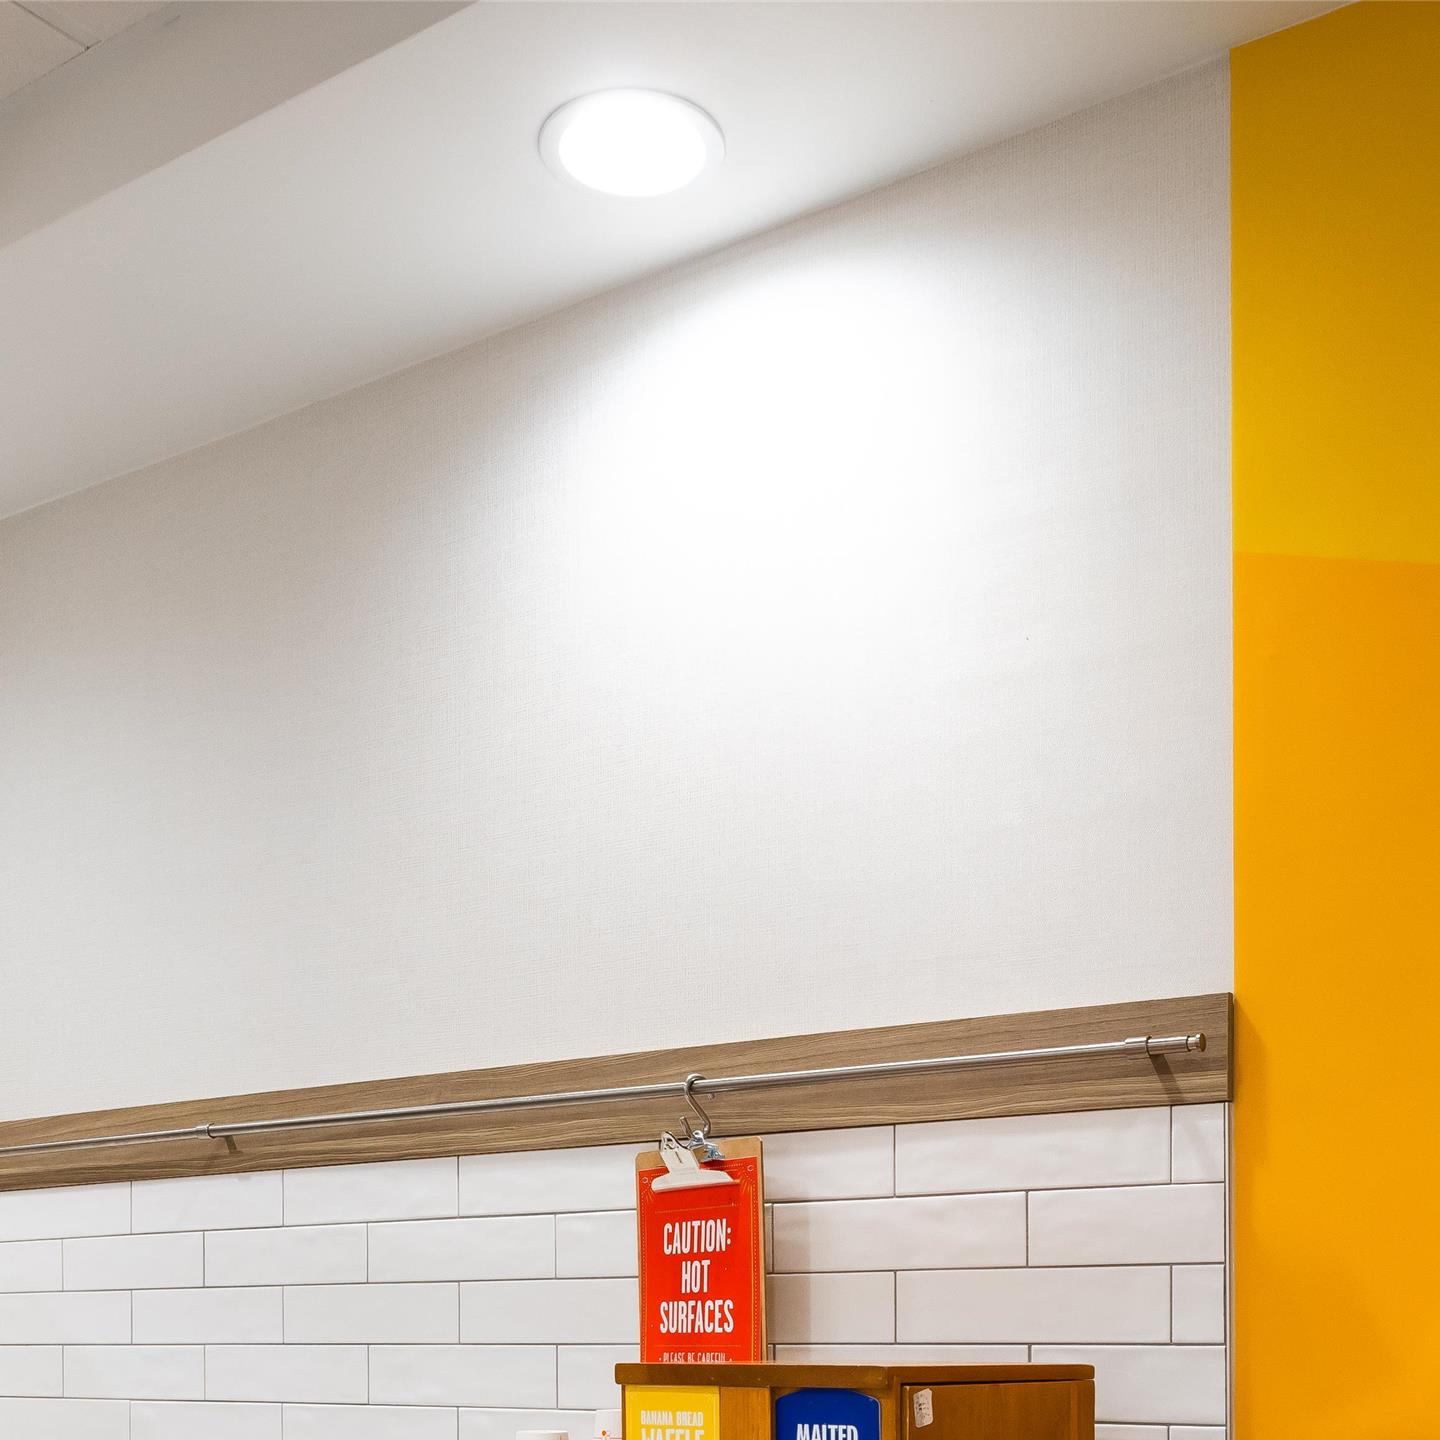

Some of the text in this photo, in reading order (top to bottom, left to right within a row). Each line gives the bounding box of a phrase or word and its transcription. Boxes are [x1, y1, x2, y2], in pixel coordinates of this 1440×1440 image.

[663, 1218, 732, 1255] CAUTION:
[681, 1259, 711, 1294] HOT
[659, 1299, 734, 1334] SURFACES
[640, 1410, 704, 1427] BANANA BREAD
